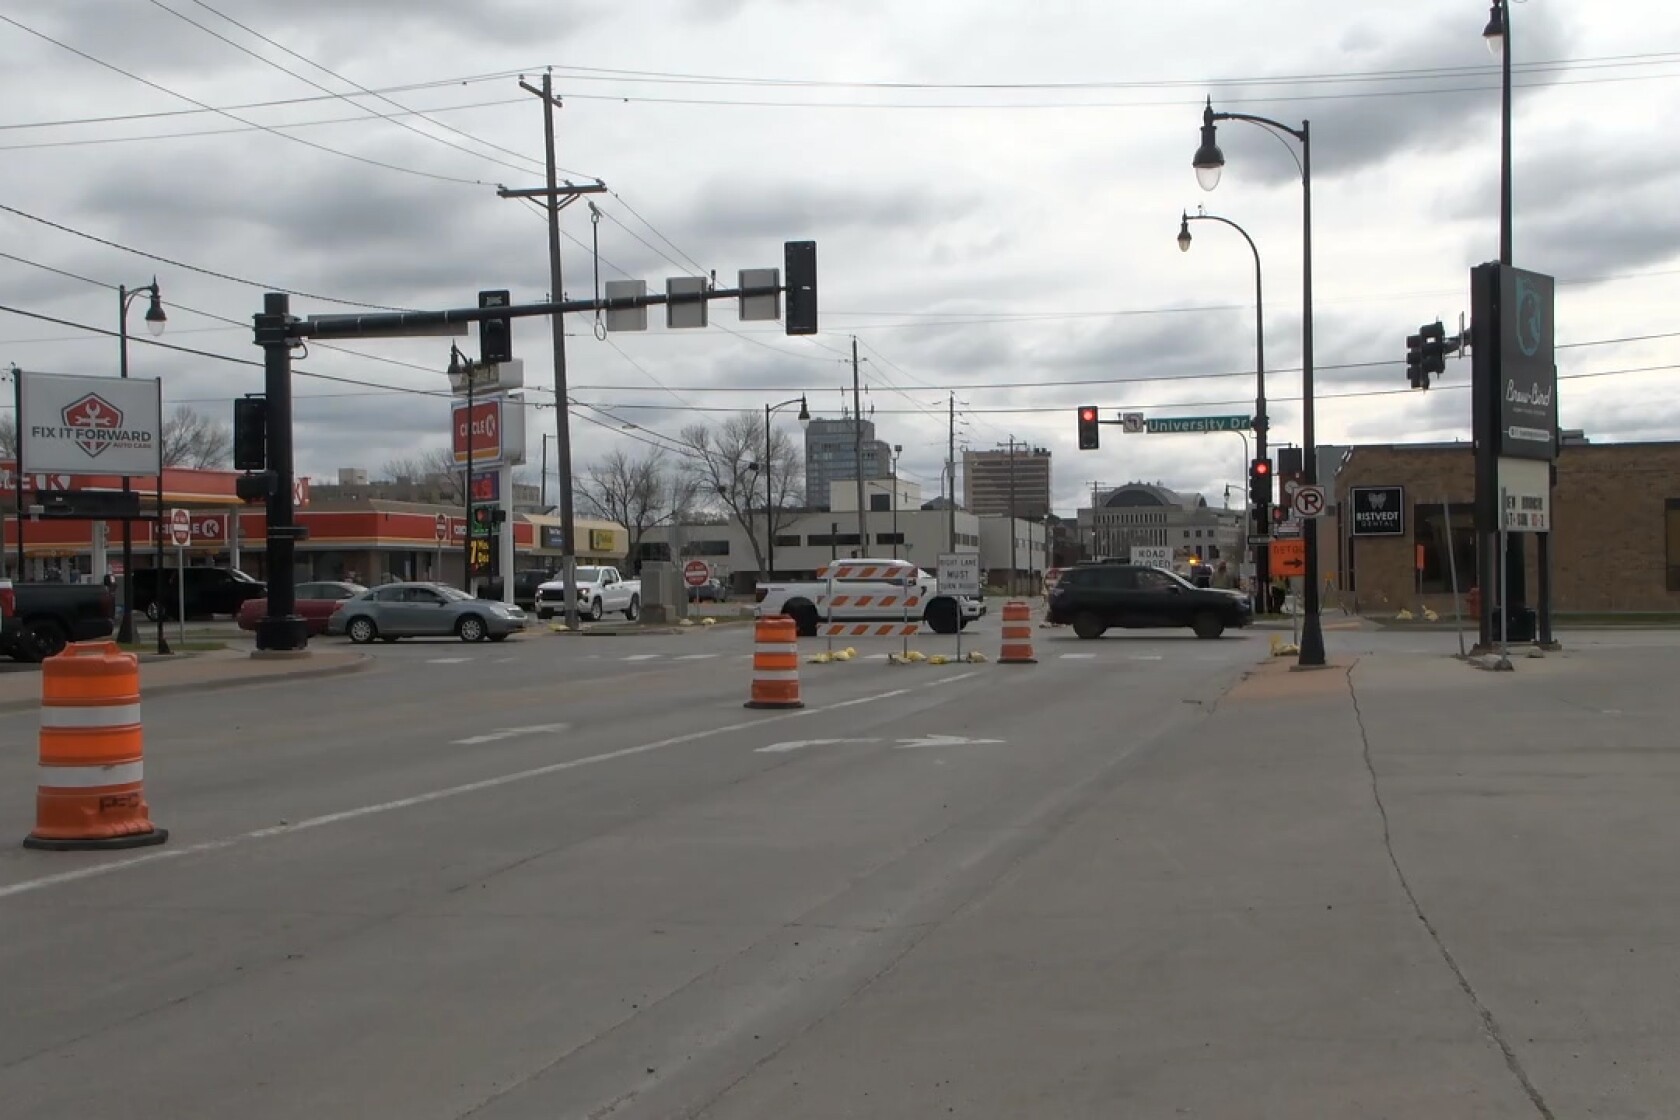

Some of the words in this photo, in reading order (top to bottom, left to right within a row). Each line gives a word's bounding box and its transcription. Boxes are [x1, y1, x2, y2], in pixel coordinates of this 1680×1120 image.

[1149, 419, 1224, 432] University
[1231, 418, 1247, 429] Dr
[32, 426, 56, 438] FIX
[59, 428, 73, 438] IT
[76, 429, 151, 442] FORWARD
[1356, 511, 1399, 520] RISTVEDT
[1138, 550, 1165, 558] ROAD
[946, 570, 968, 579] MUST
